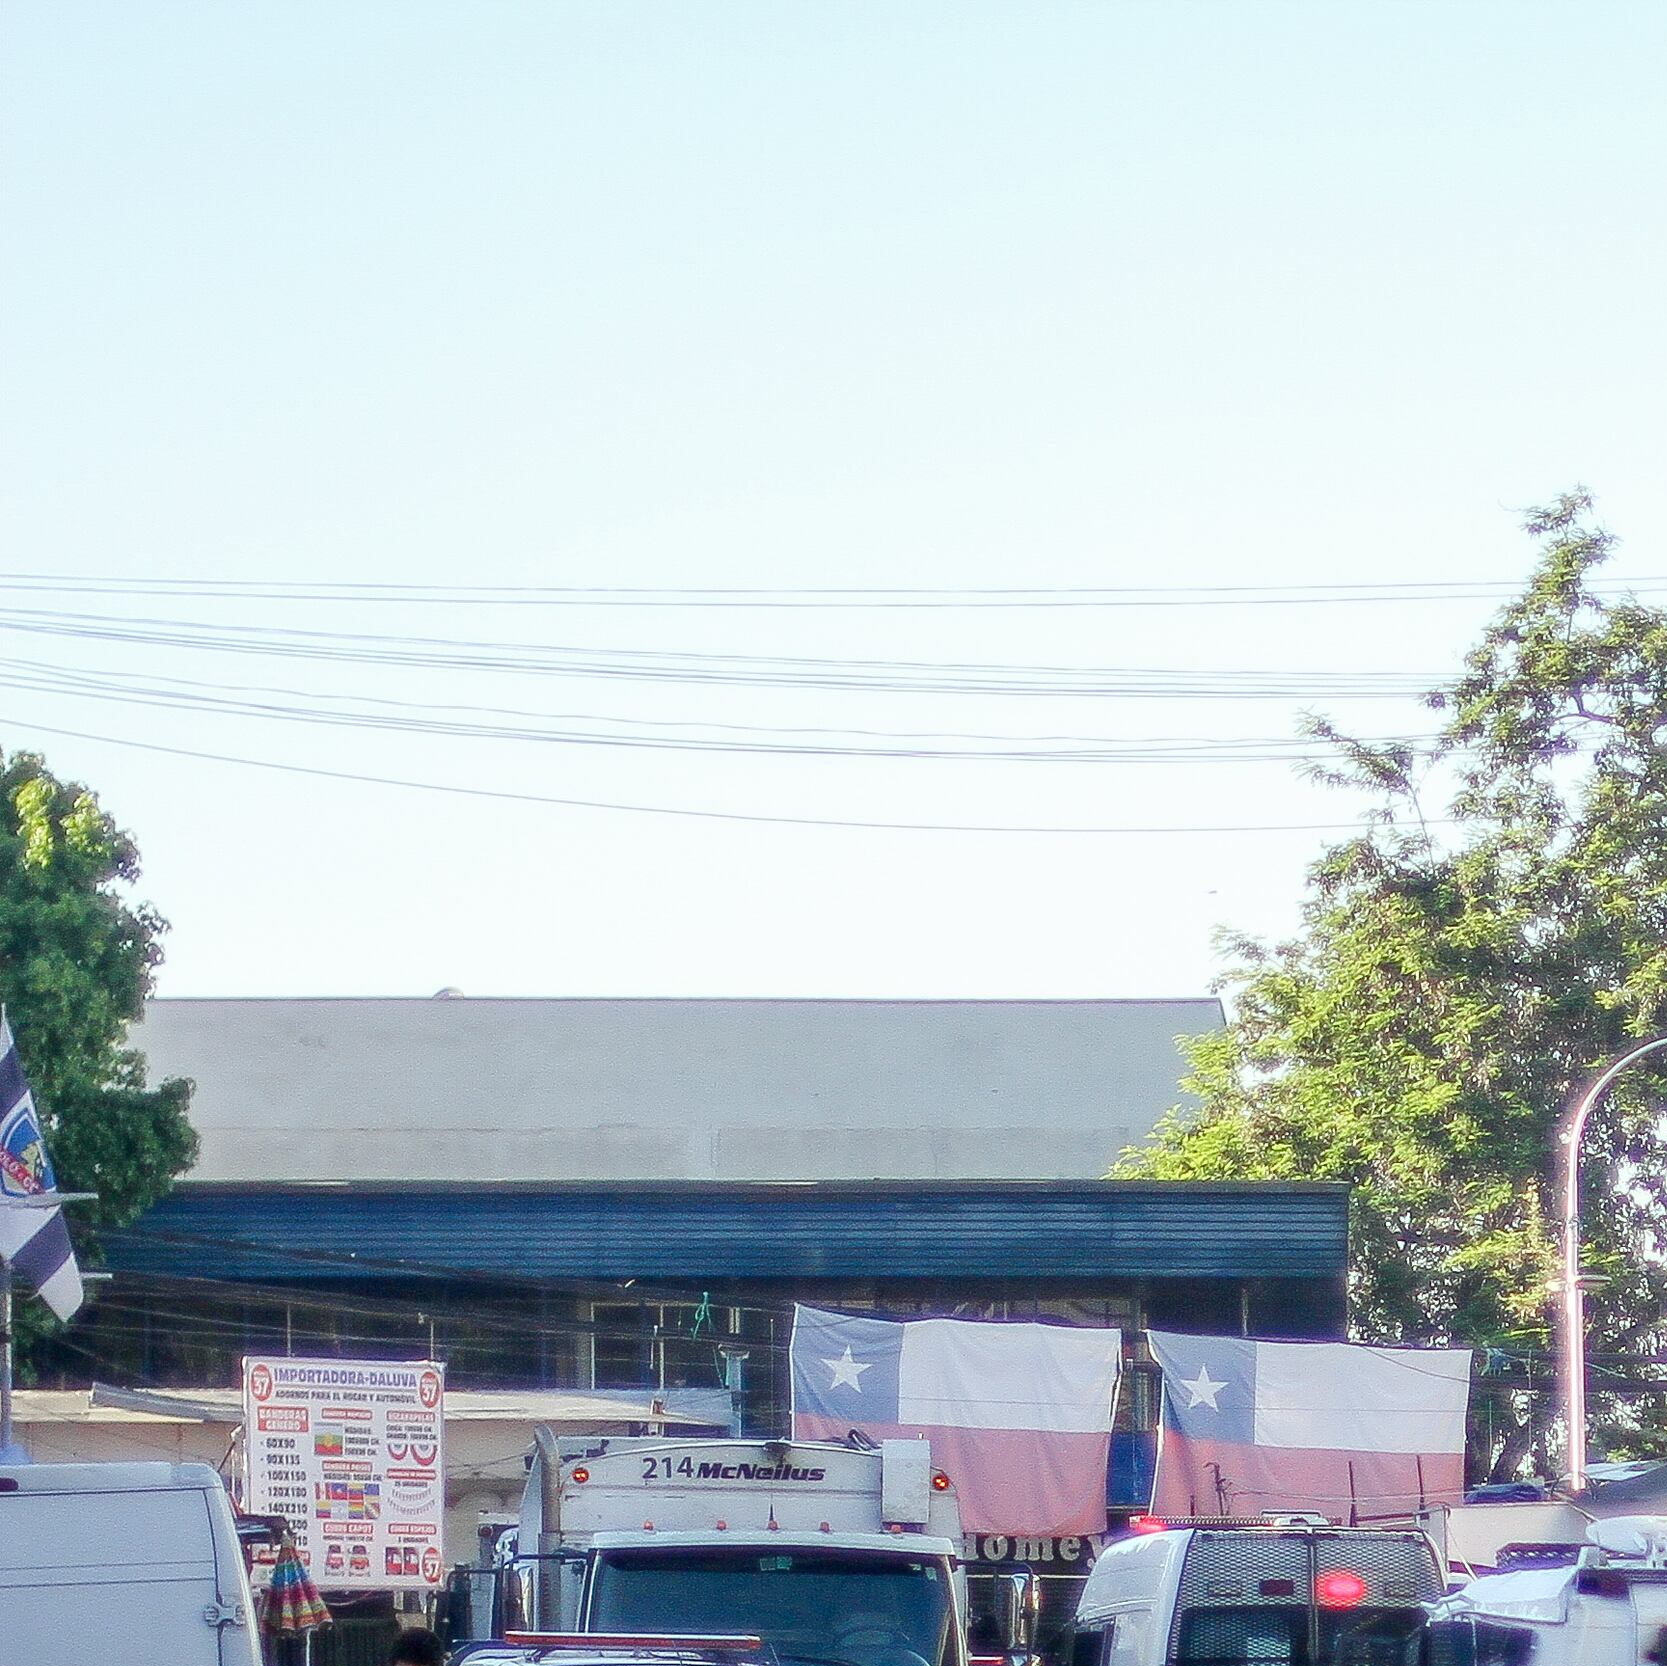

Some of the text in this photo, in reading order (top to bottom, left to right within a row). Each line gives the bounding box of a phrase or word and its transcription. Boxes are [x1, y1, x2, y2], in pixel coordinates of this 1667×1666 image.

[311, 1391, 331, 1401] PARA
[642, 1456, 826, 1481] 214 McNeilus
